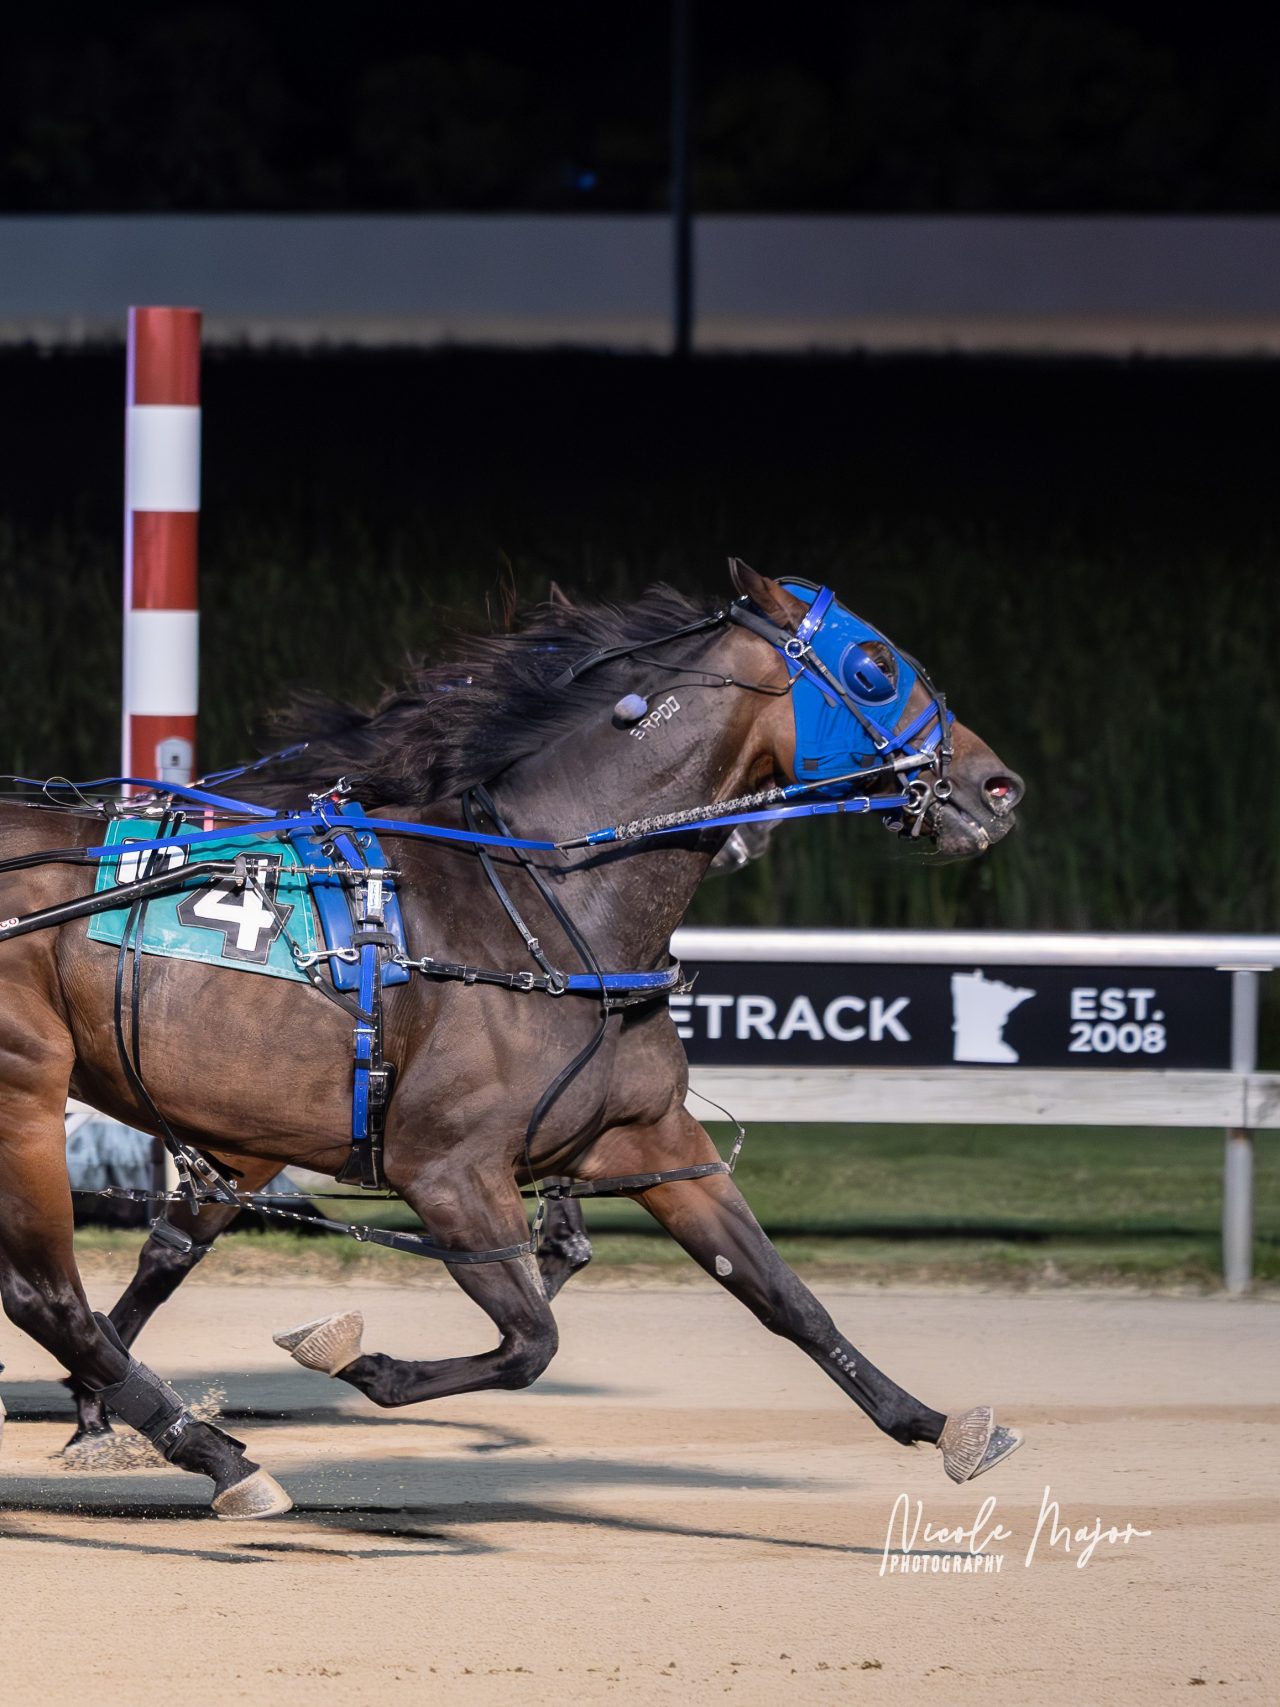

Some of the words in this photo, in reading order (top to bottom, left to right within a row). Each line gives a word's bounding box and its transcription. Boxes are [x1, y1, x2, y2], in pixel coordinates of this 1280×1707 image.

[185, 855, 283, 957] 4
[1070, 986, 1165, 1021] EST.
[1068, 1021, 1167, 1054] 2008
